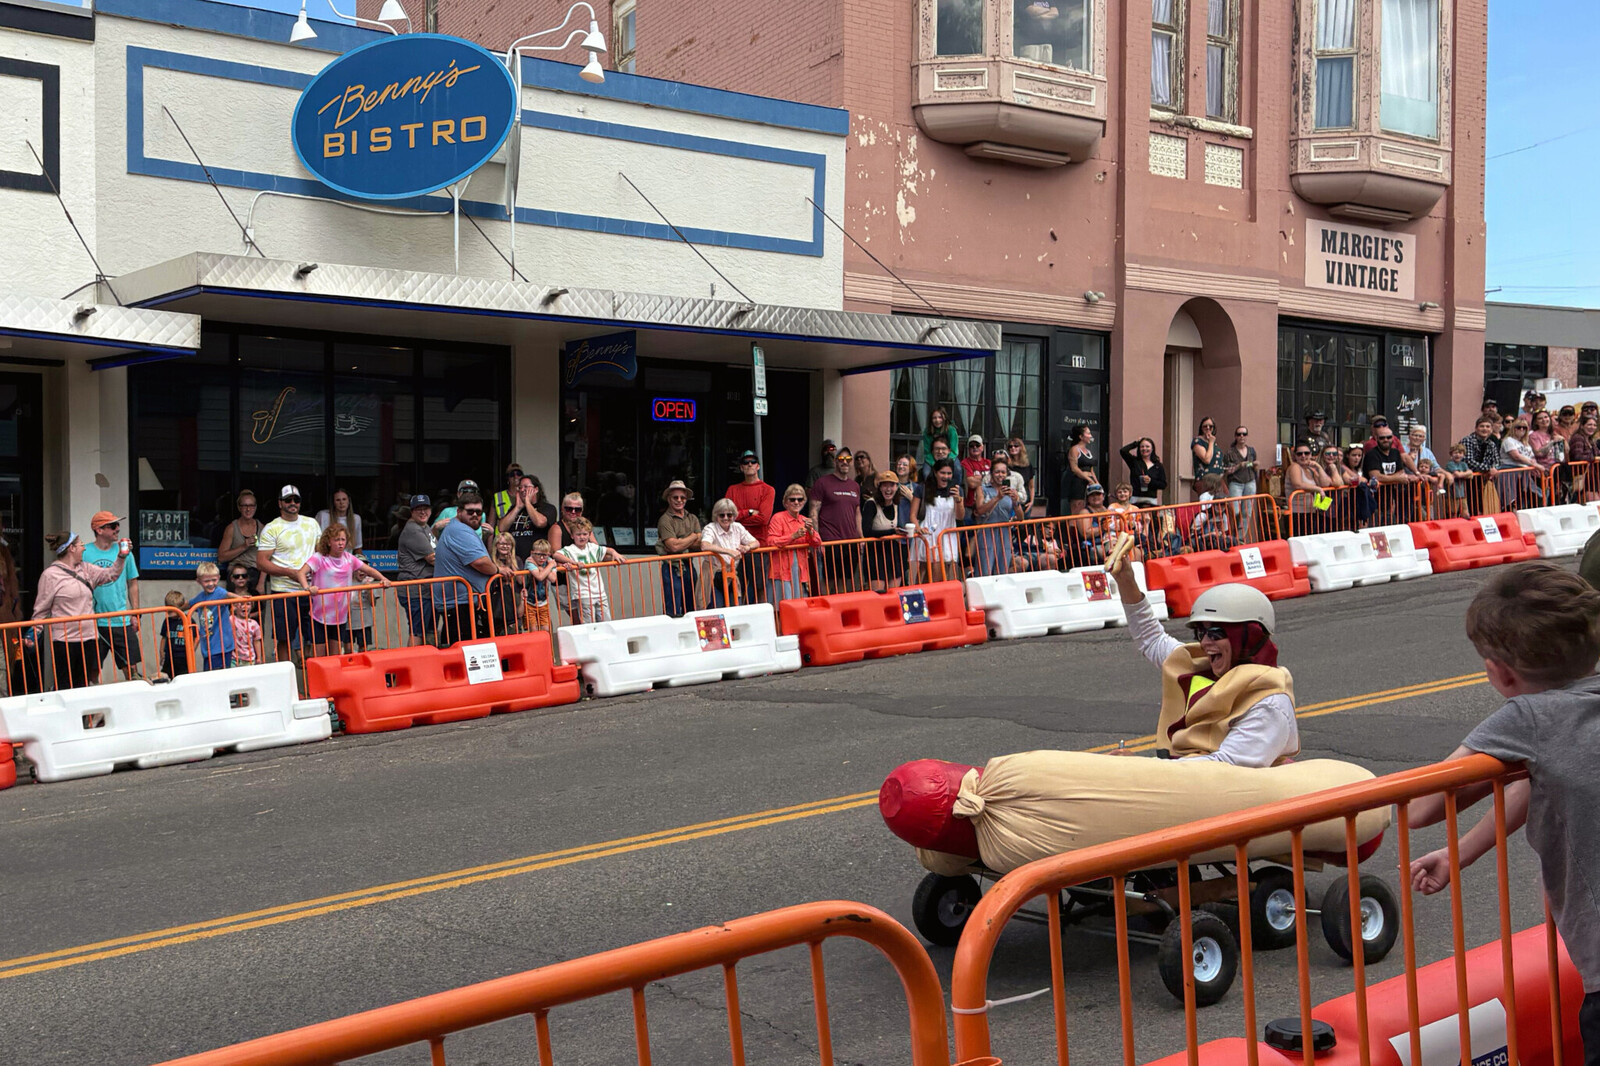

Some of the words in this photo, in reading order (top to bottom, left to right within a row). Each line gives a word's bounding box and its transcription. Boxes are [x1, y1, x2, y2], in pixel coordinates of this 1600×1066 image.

[318, 59, 480, 129] Benny's
[323, 116, 487, 158] BISTRO
[1321, 228, 1404, 263] MARGIE'S
[1325, 260, 1399, 292] VINTAGE
[1071, 355, 1087, 368] 110
[655, 401, 695, 419] OPEN
[147, 513, 181, 523] FARM
[147, 530, 182, 540] FORK
